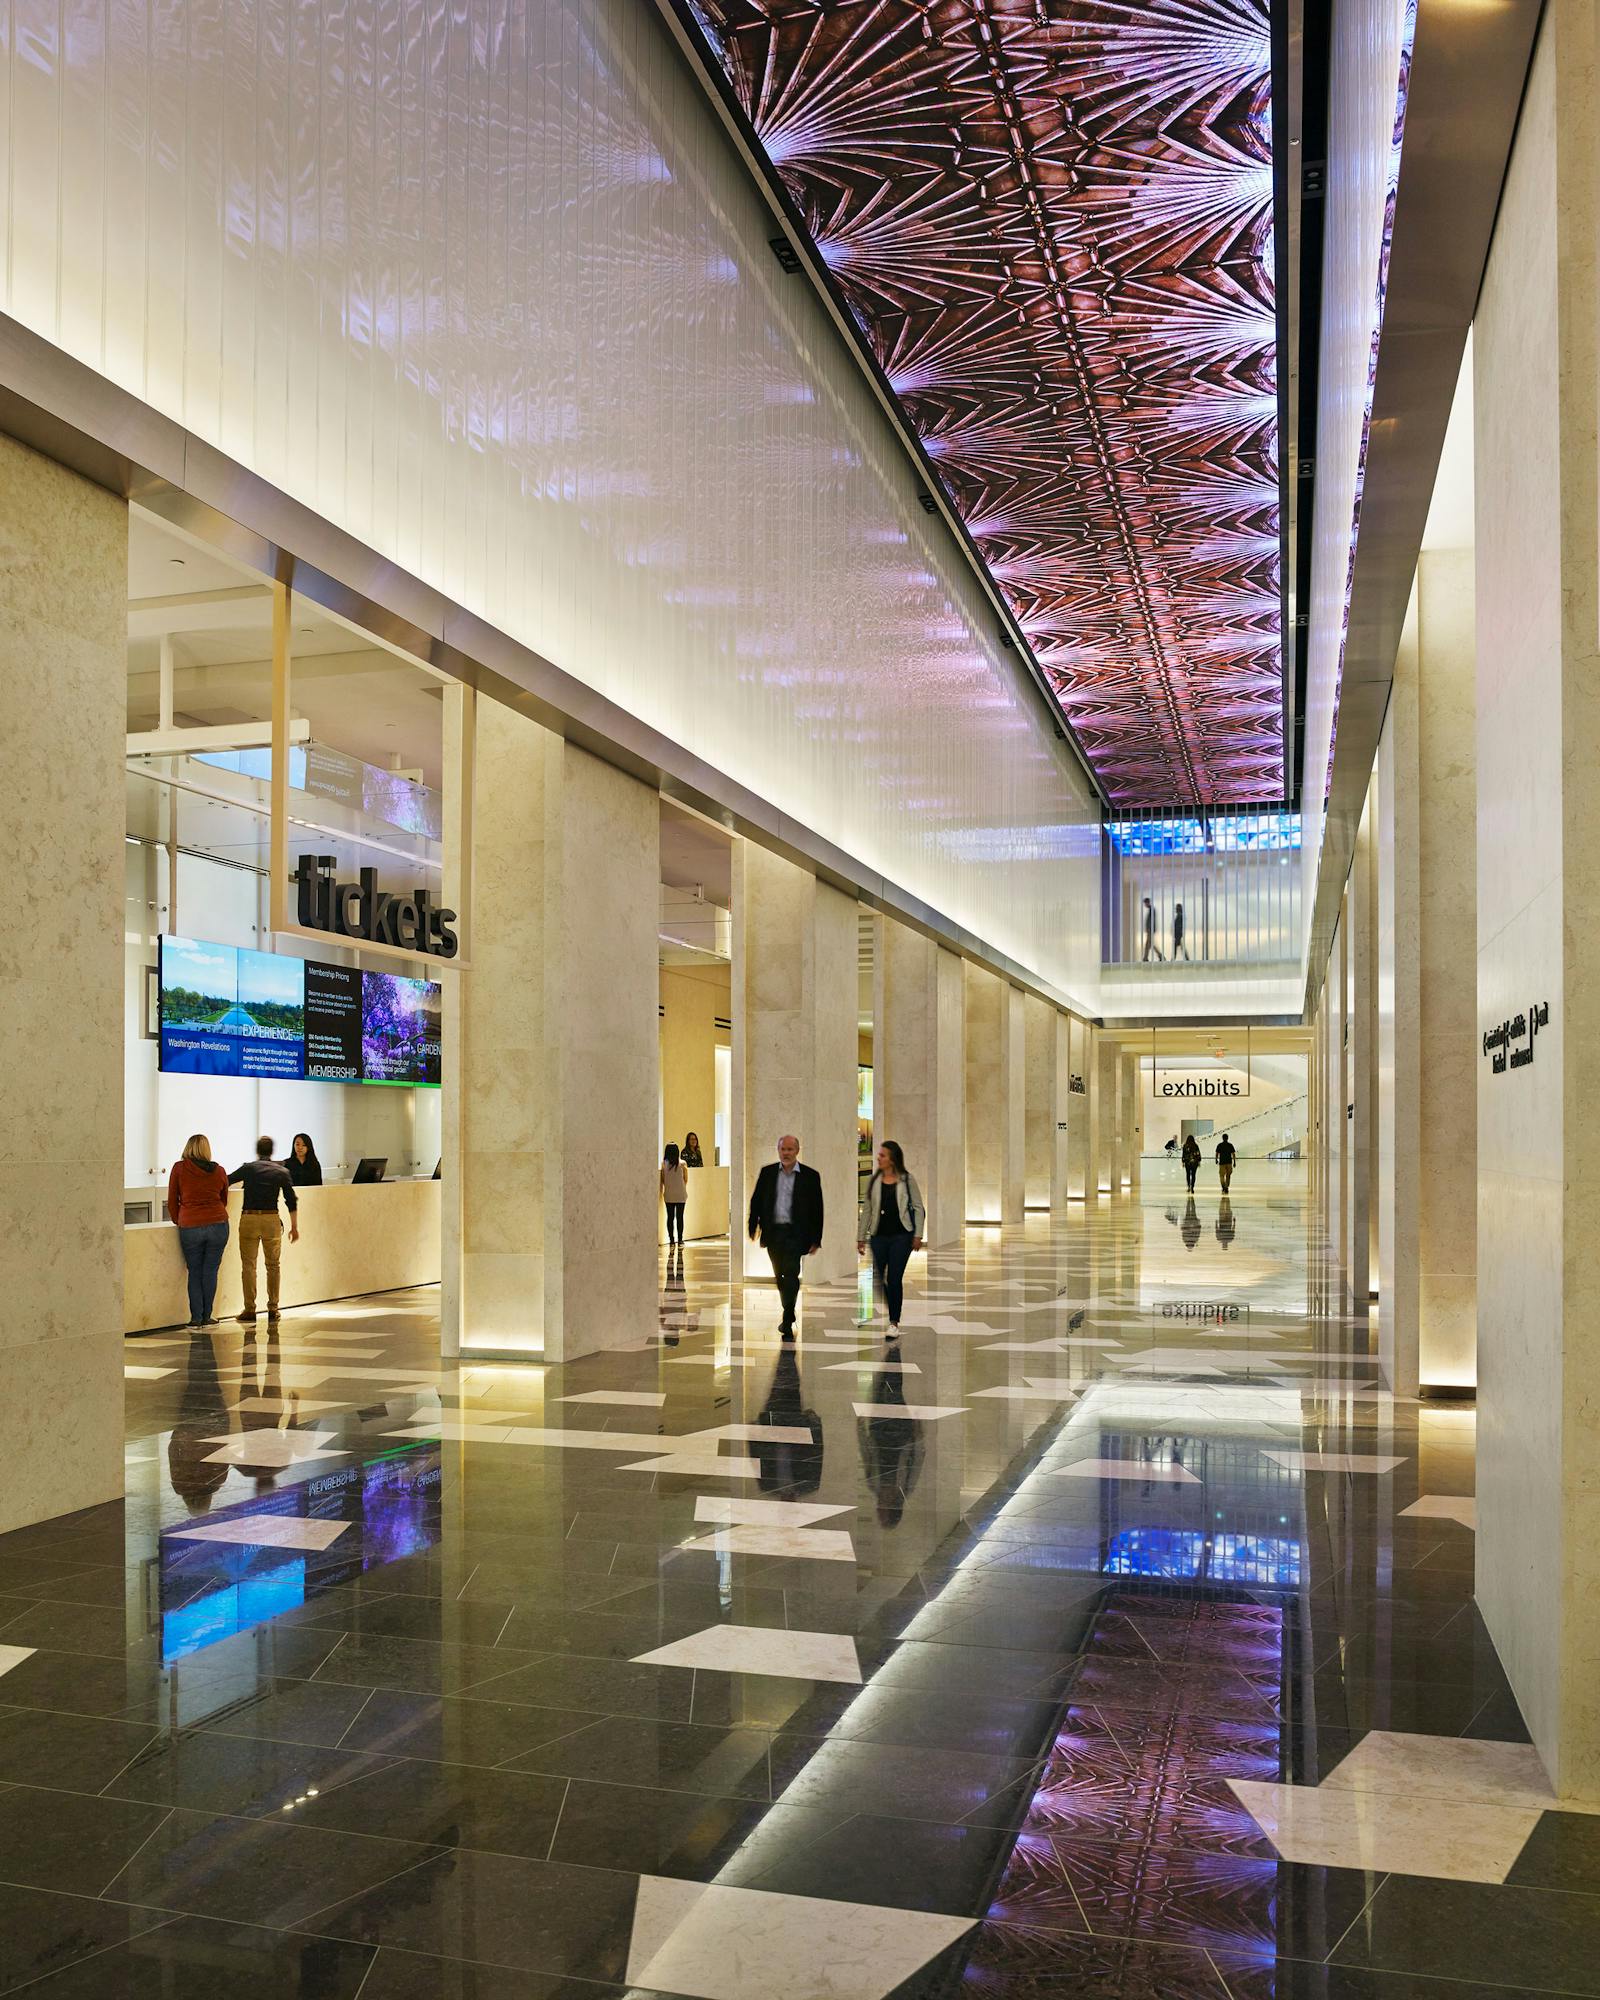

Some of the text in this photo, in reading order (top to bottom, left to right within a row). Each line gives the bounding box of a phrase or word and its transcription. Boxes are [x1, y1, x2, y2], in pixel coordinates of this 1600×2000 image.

[294, 854, 458, 959] tickets
[308, 967, 335, 979] Membership
[243, 1025, 293, 1040] EXPERIENCE
[168, 1038, 230, 1052] Washington Revelations
[309, 1064, 357, 1079] MEMBERSHIP
[1163, 1079, 1240, 1096] exhibits
